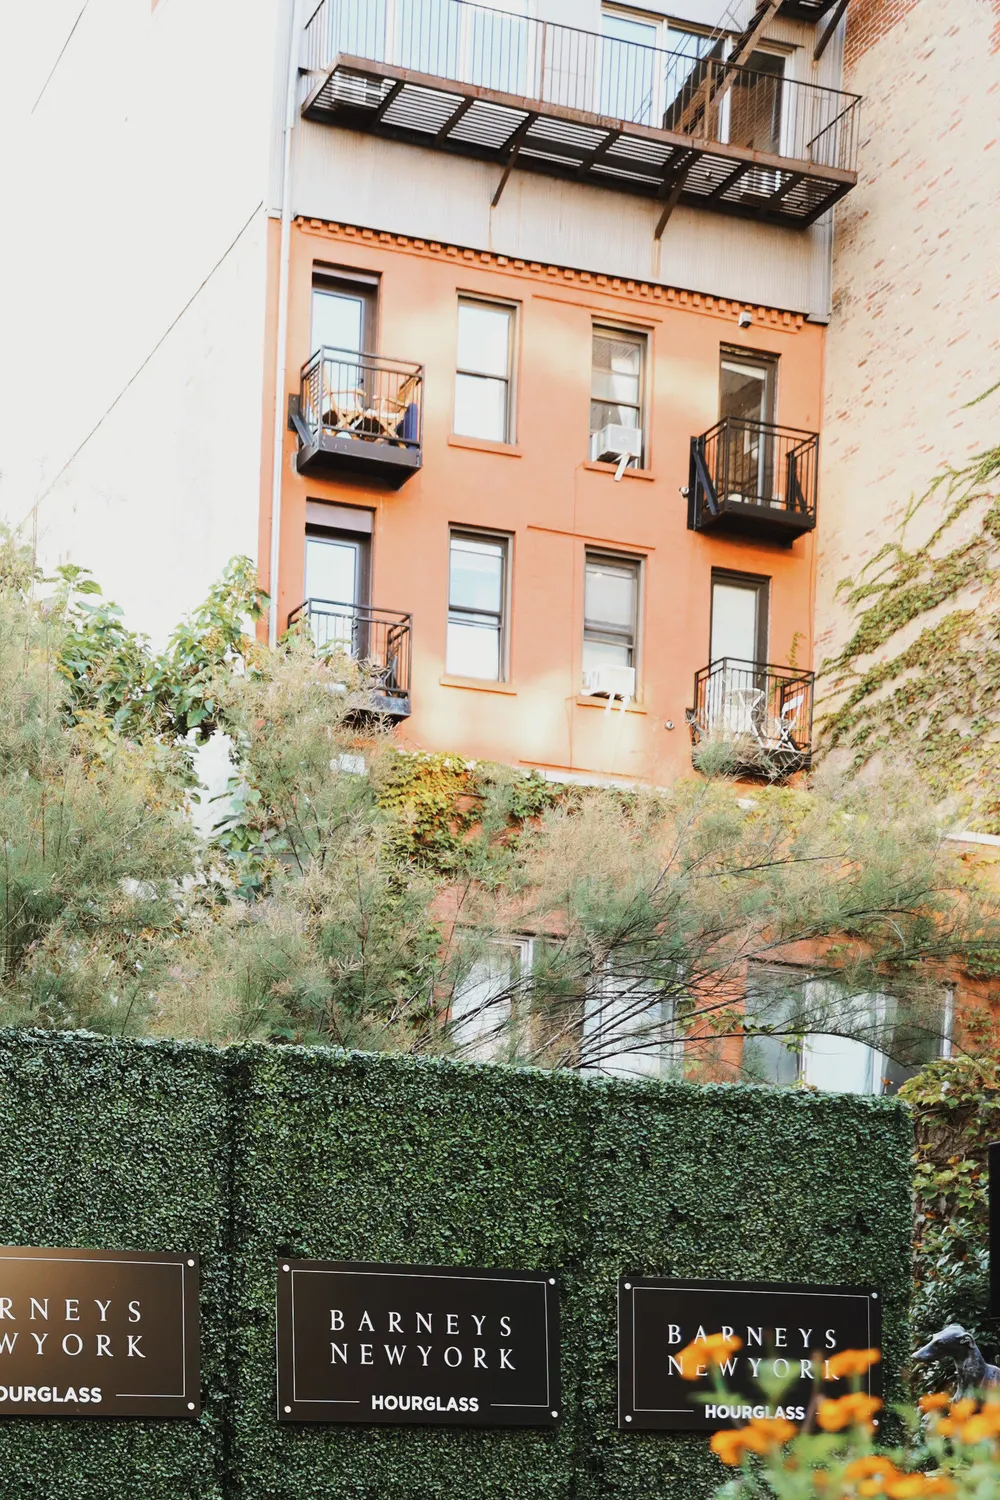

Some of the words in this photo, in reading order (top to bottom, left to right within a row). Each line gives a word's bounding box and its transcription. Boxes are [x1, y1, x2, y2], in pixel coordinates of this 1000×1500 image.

[330, 1309, 512, 1337] BARNEYS
[667, 1324, 836, 1349] BARNEYS
[371, 1395, 479, 1412] HOURGLASS
[705, 1404, 805, 1421] HOURGLASS
